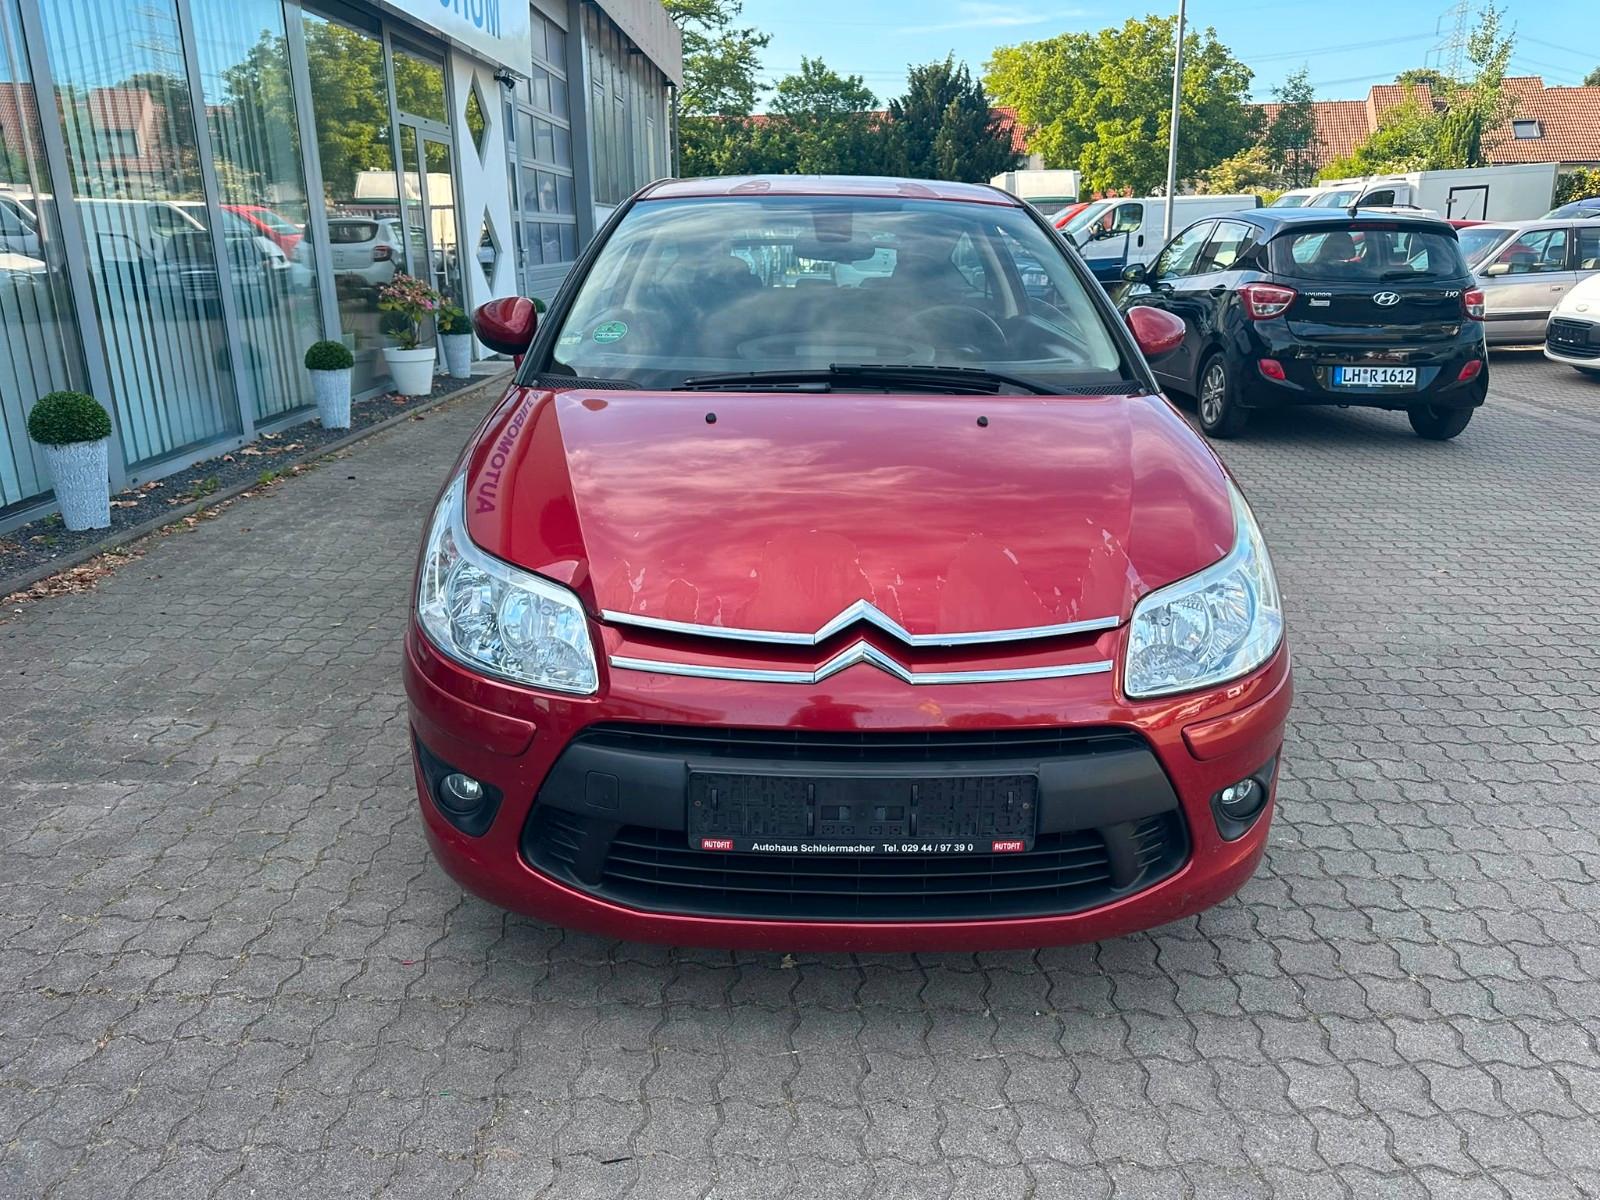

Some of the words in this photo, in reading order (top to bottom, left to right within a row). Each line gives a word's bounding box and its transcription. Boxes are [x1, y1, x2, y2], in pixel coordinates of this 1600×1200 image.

[1343, 368, 1361, 382] LH
[1369, 369, 1378, 383] R
[1380, 369, 1414, 383] 1612
[703, 840, 732, 849] AUTOFIT
[752, 843, 799, 852] Autohaus
[800, 843, 875, 853] Schleiermacher
[882, 844, 899, 852] Tel.
[901, 843, 919, 852] 029
[920, 843, 933, 852] 44
[939, 843, 951, 852] 97
[953, 843, 965, 851] 39
[967, 843, 974, 851] 0
[994, 842, 1021, 850] AUTOFIT
